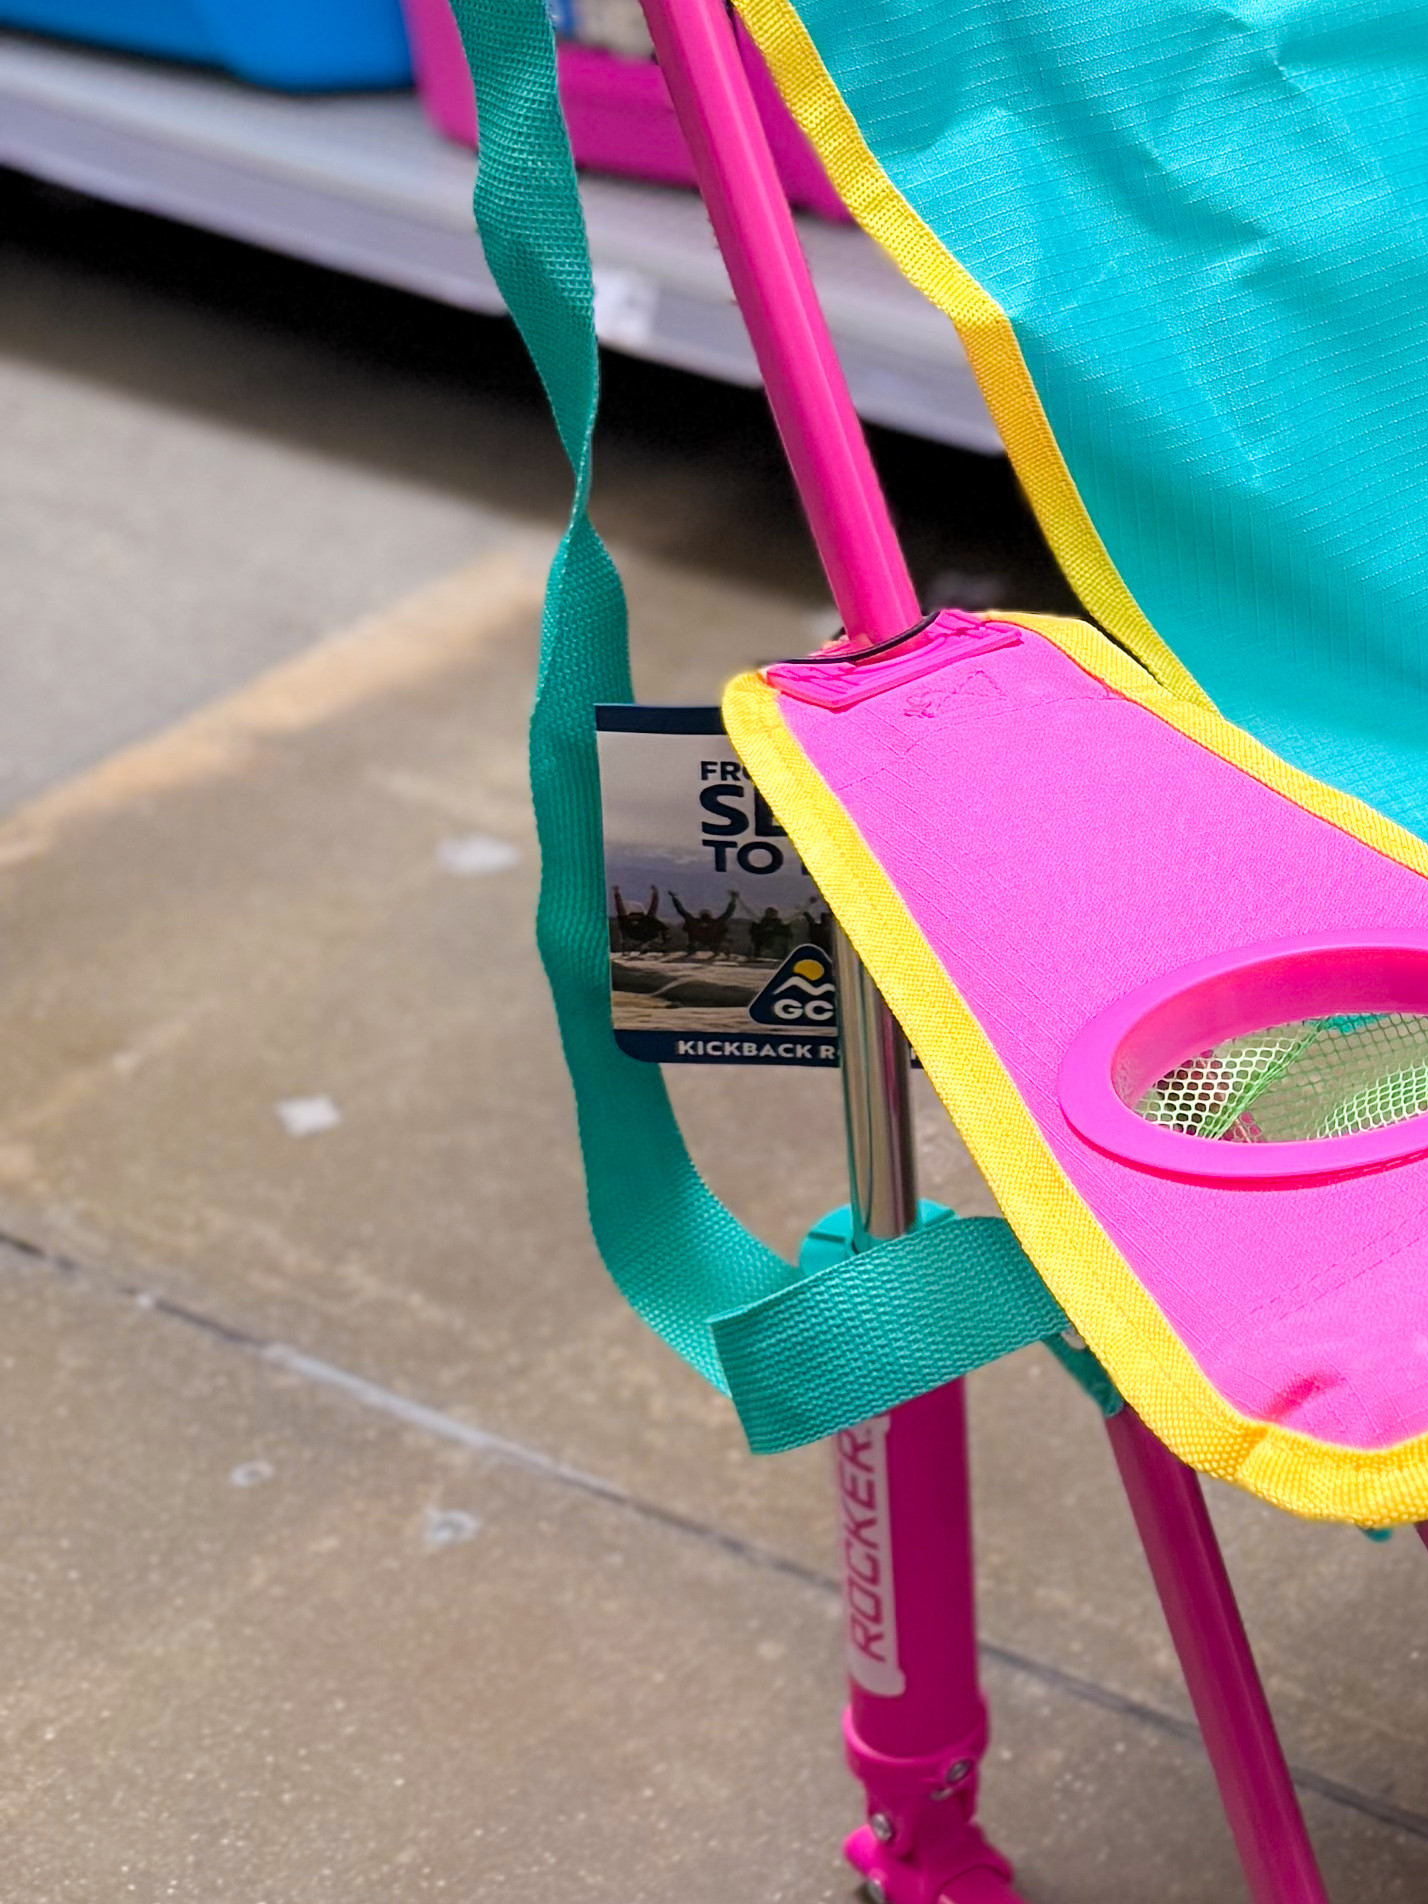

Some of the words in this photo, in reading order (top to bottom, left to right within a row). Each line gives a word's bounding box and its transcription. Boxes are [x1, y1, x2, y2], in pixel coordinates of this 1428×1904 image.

[702, 839, 784, 875] TO
[774, 998, 835, 1021] GC
[678, 1039, 813, 1059] KICKBACK
[839, 1424, 885, 1663] ROCKER
